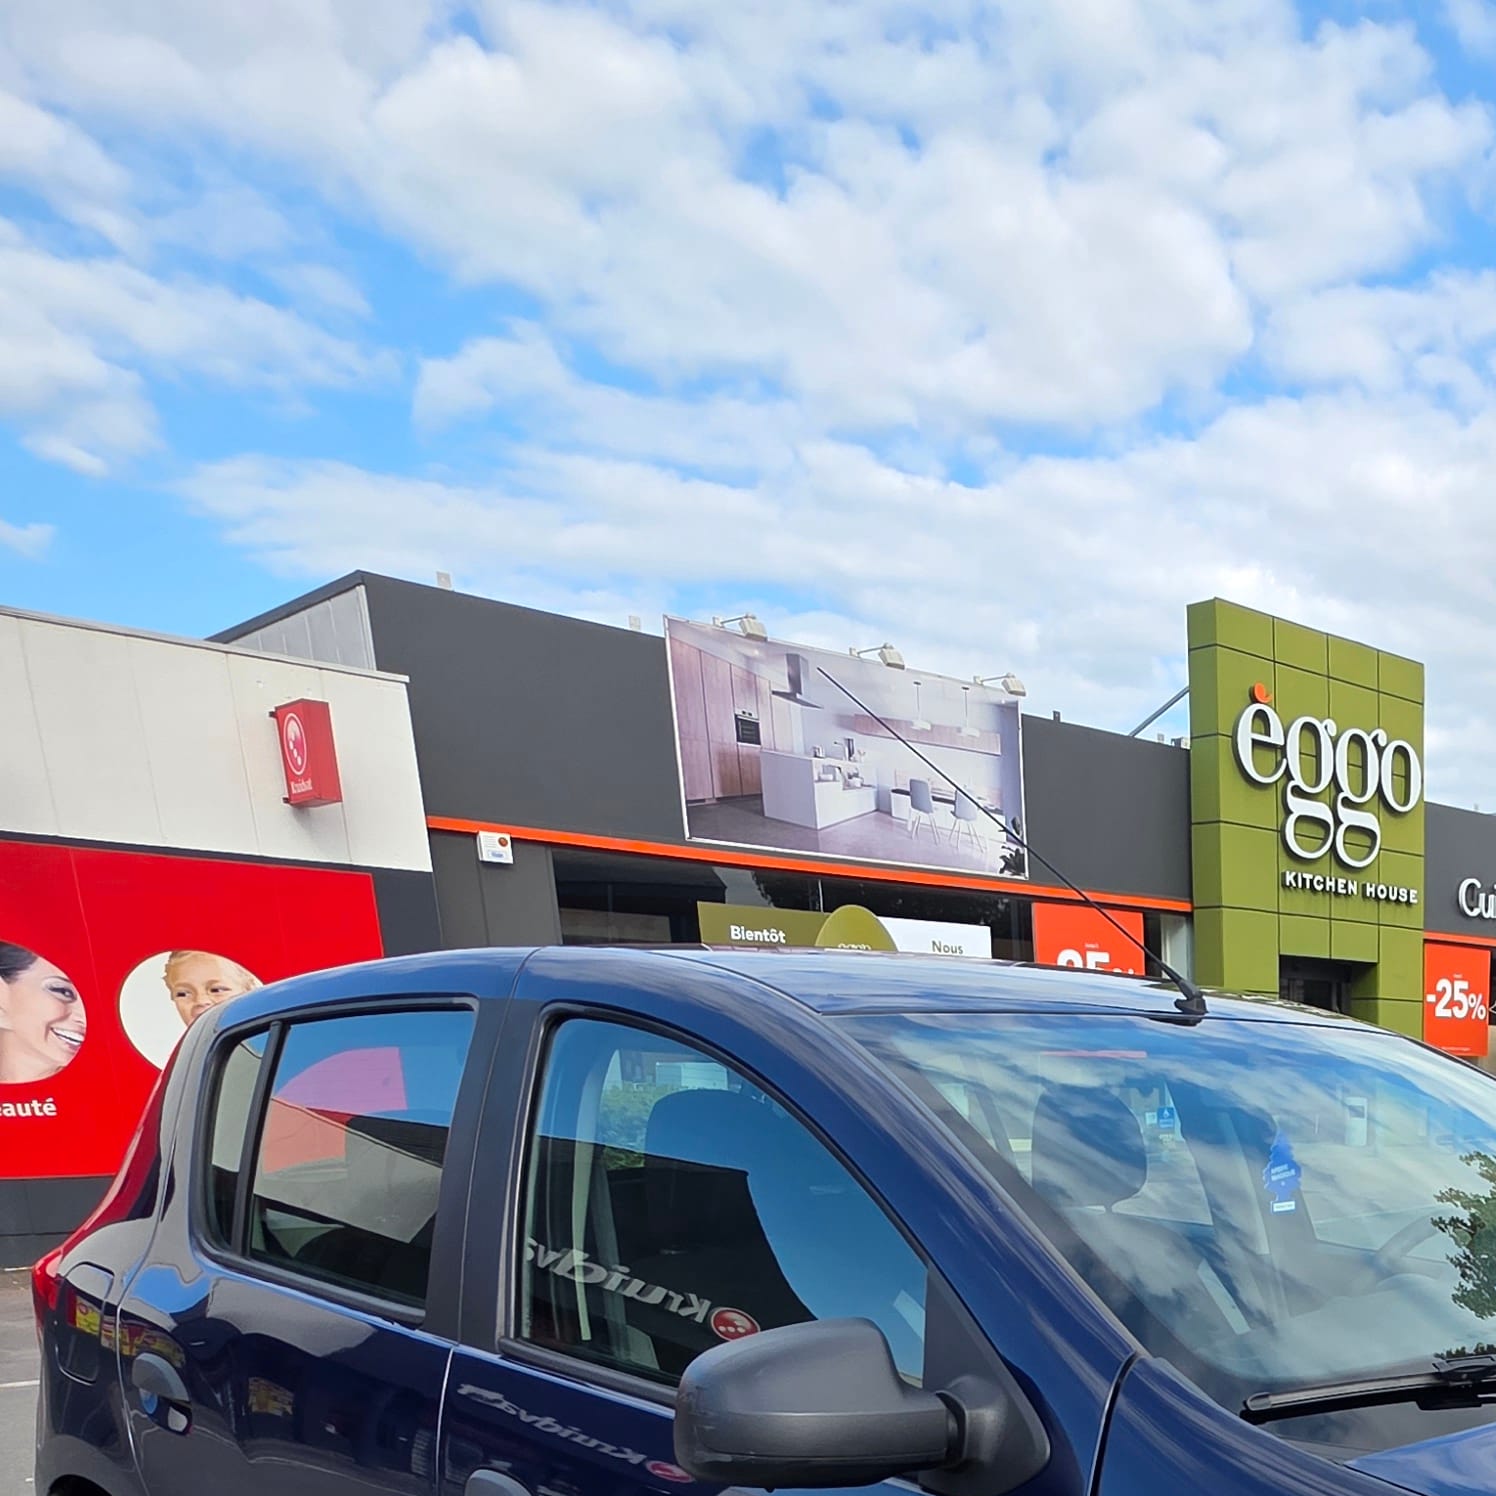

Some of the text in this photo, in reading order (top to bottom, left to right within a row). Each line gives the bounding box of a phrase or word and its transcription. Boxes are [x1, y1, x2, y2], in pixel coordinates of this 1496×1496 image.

[1285, 870, 1418, 904] KITCHEN HOUSE
[730, 925, 786, 944] Bientôt
[931, 940, 964, 955] Nous
[1426, 978, 1487, 1020] -25%
